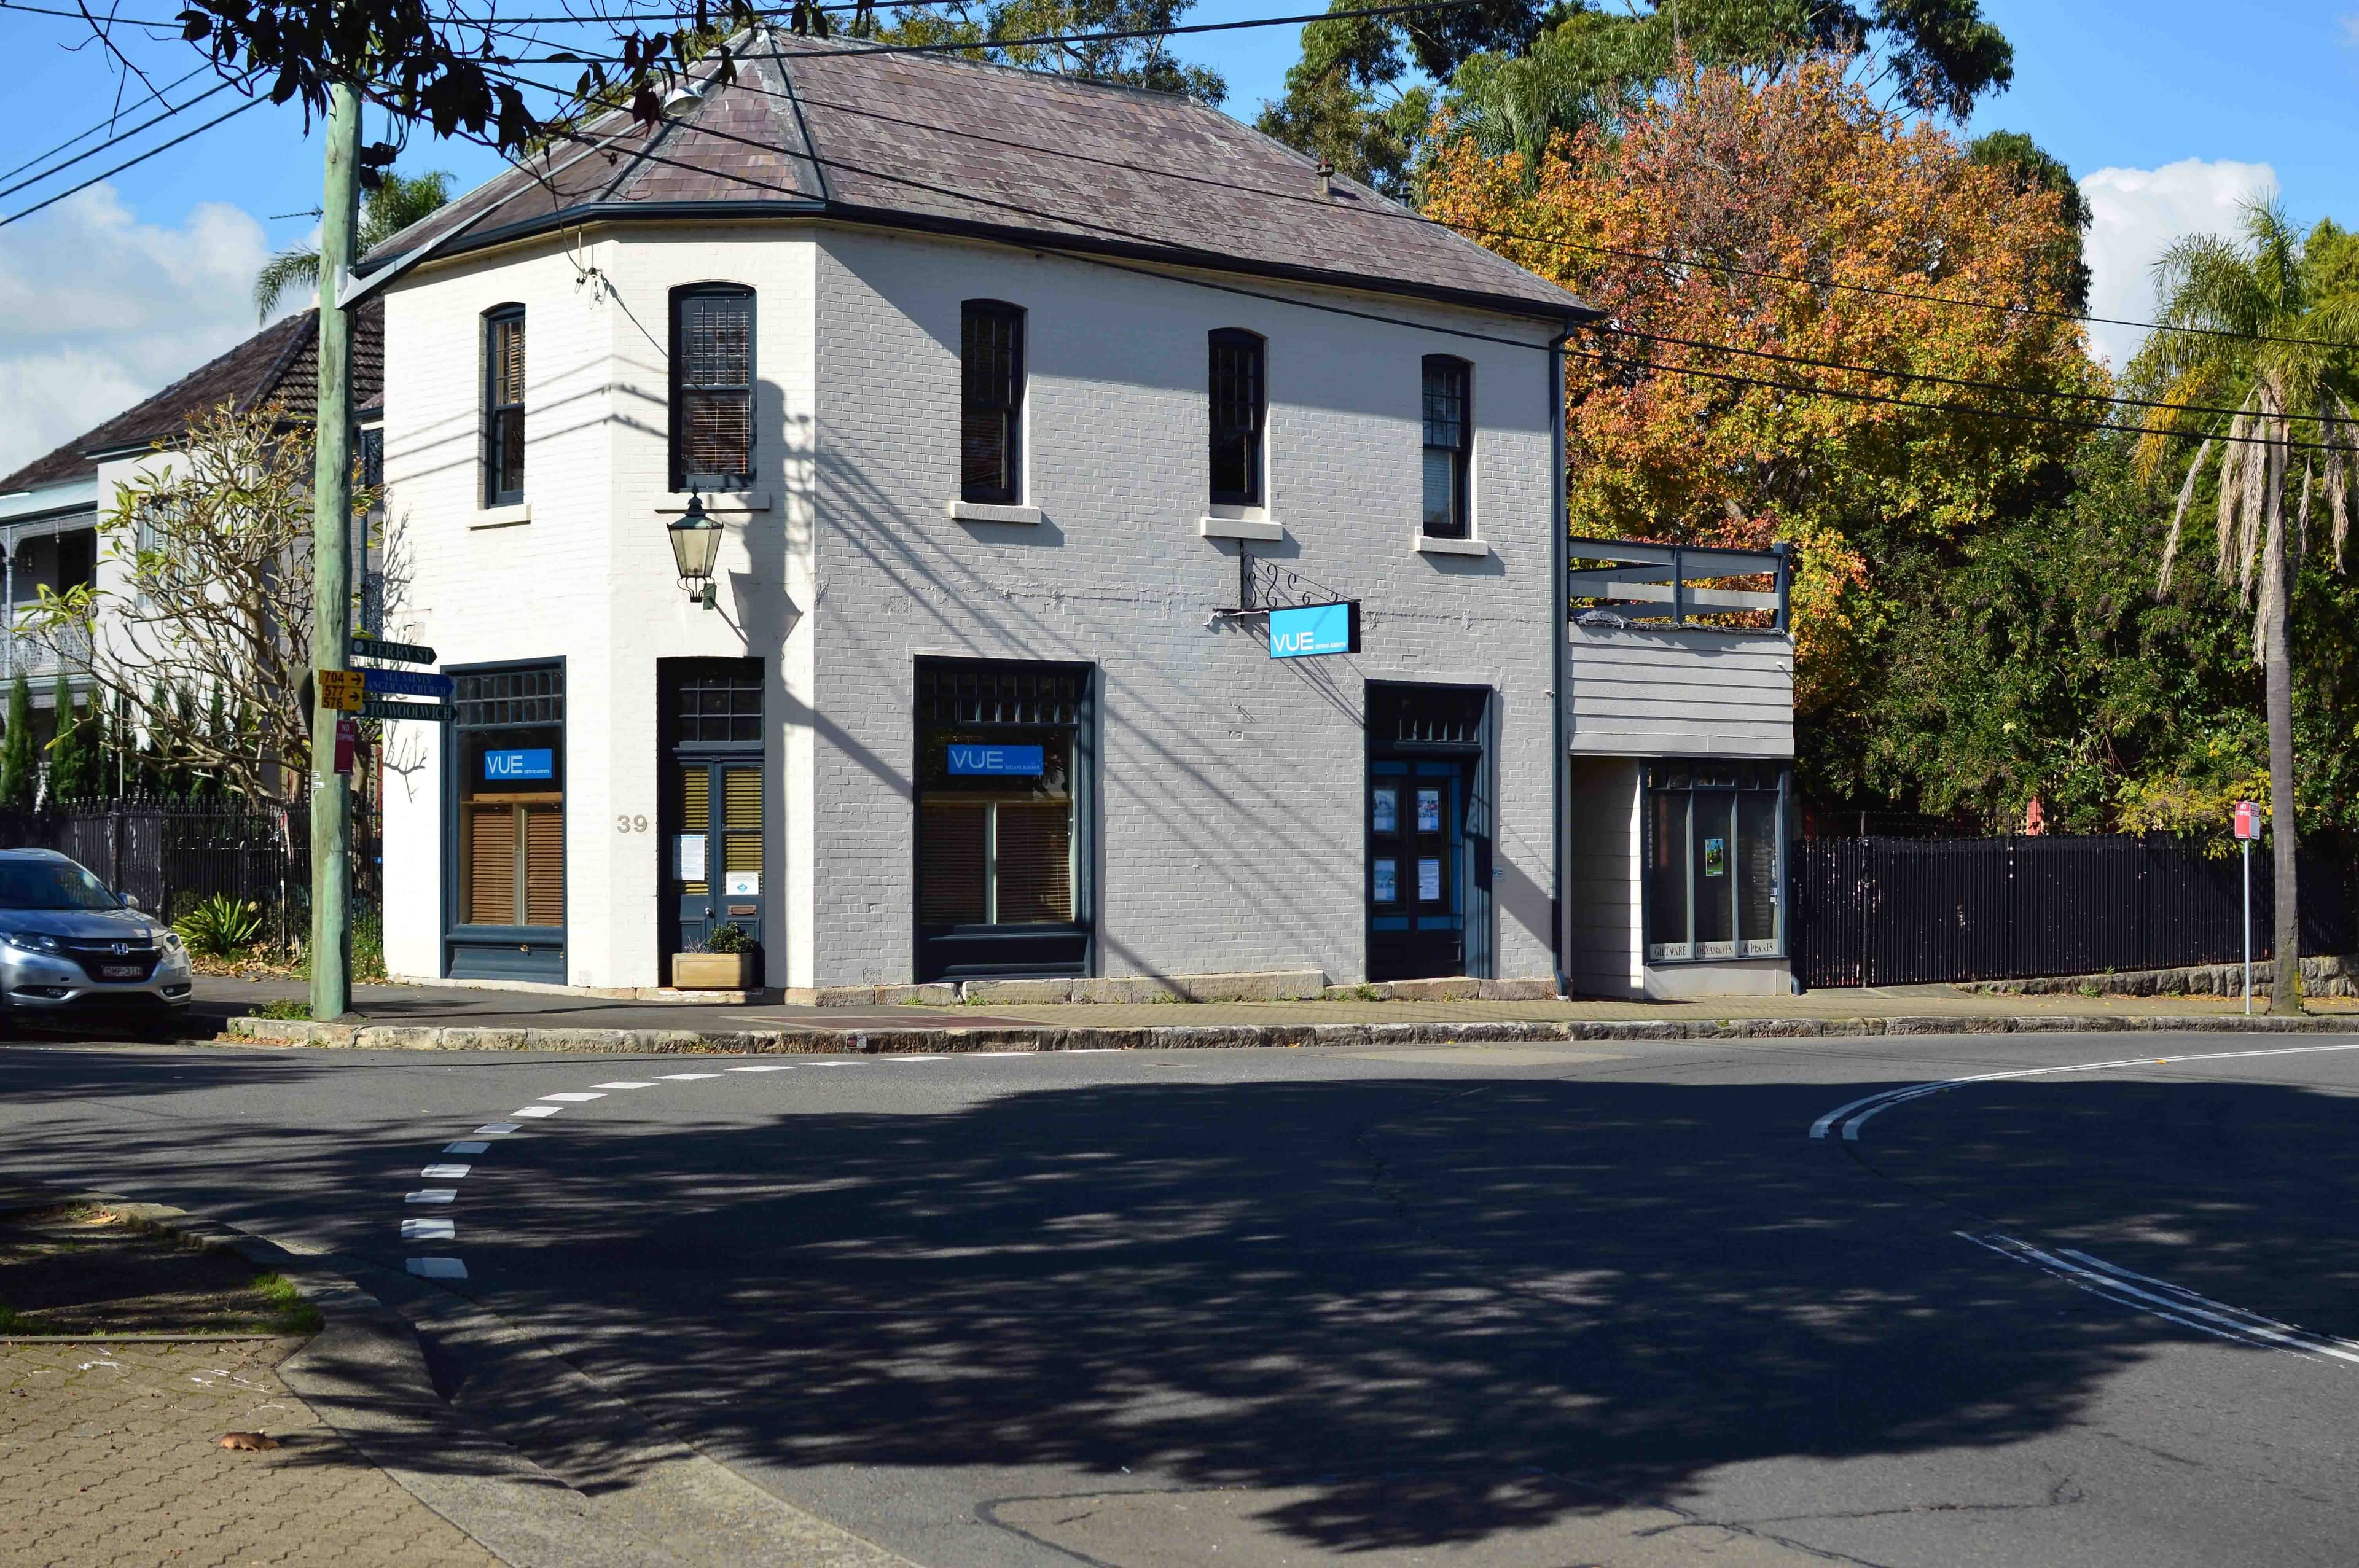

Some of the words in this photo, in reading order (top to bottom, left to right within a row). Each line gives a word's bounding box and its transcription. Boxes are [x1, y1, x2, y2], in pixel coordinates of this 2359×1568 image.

[1273, 631, 1313, 652] VUE
[369, 642, 410, 660] FERRY
[417, 649, 432, 662] ST
[324, 672, 344, 683] 704
[385, 673, 399, 681] ALL
[325, 685, 344, 697] 577
[368, 681, 409, 692] ANGLICAN
[411, 684, 447, 695] CHURCH
[323, 696, 343, 708] 576
[370, 703, 385, 716] TO
[388, 704, 452, 719] WOOLWICH
[342, 724, 350, 733] NO
[487, 755, 523, 774] VUE
[951, 750, 1003, 769] VUE
[617, 814, 647, 833] 39
[1654, 945, 1686, 956] GIFTWARE
[1697, 943, 1732, 955] ORNAMENTS
[1743, 943, 1749, 953] &
[1750, 942, 1773, 953] PLANTS
